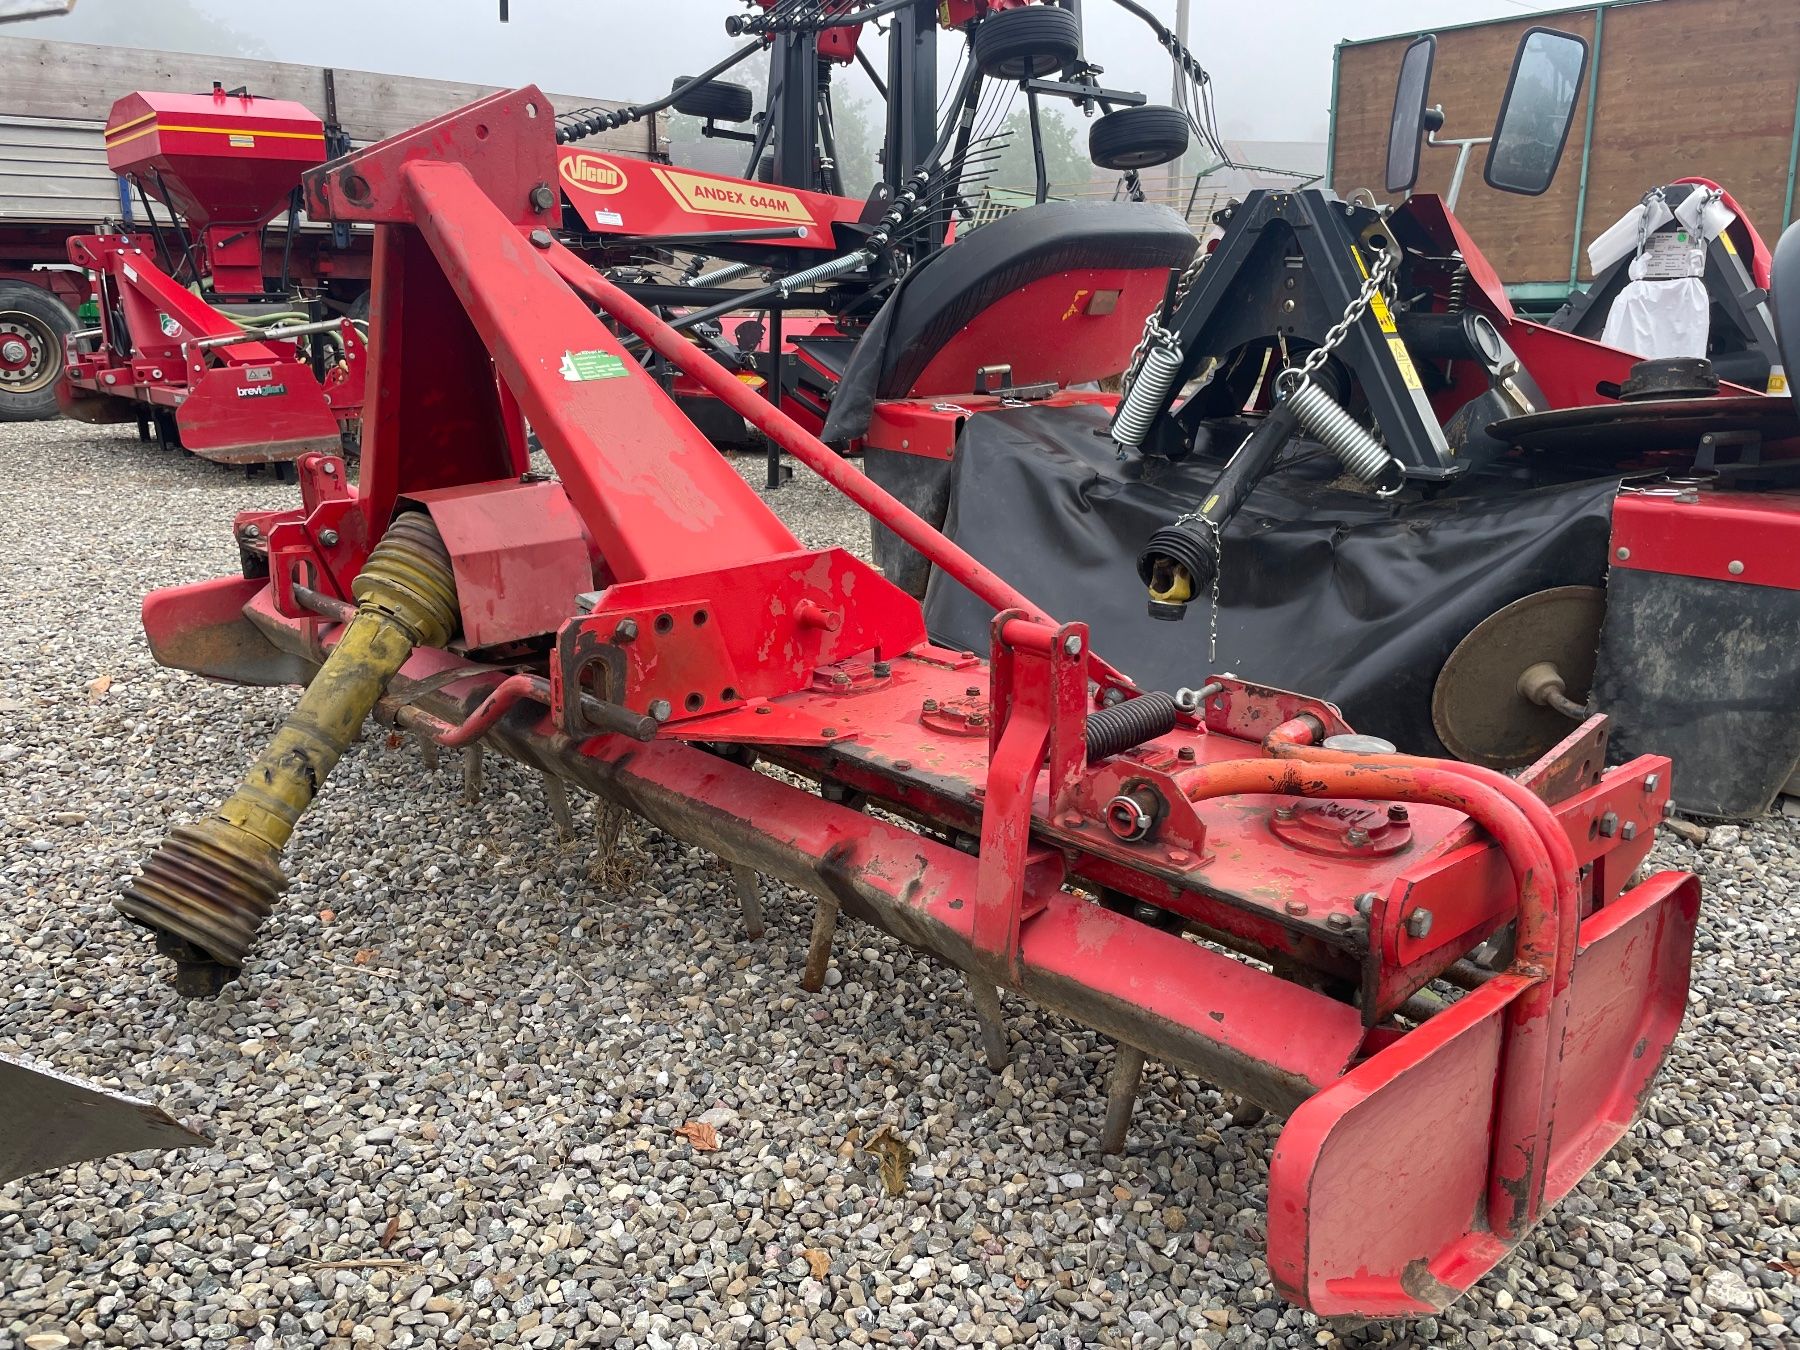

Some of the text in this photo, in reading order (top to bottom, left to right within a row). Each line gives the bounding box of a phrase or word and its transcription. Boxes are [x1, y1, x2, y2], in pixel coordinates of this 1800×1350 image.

[567, 155, 619, 186] Vicon
[694, 185, 790, 212] ANDEX 644M
